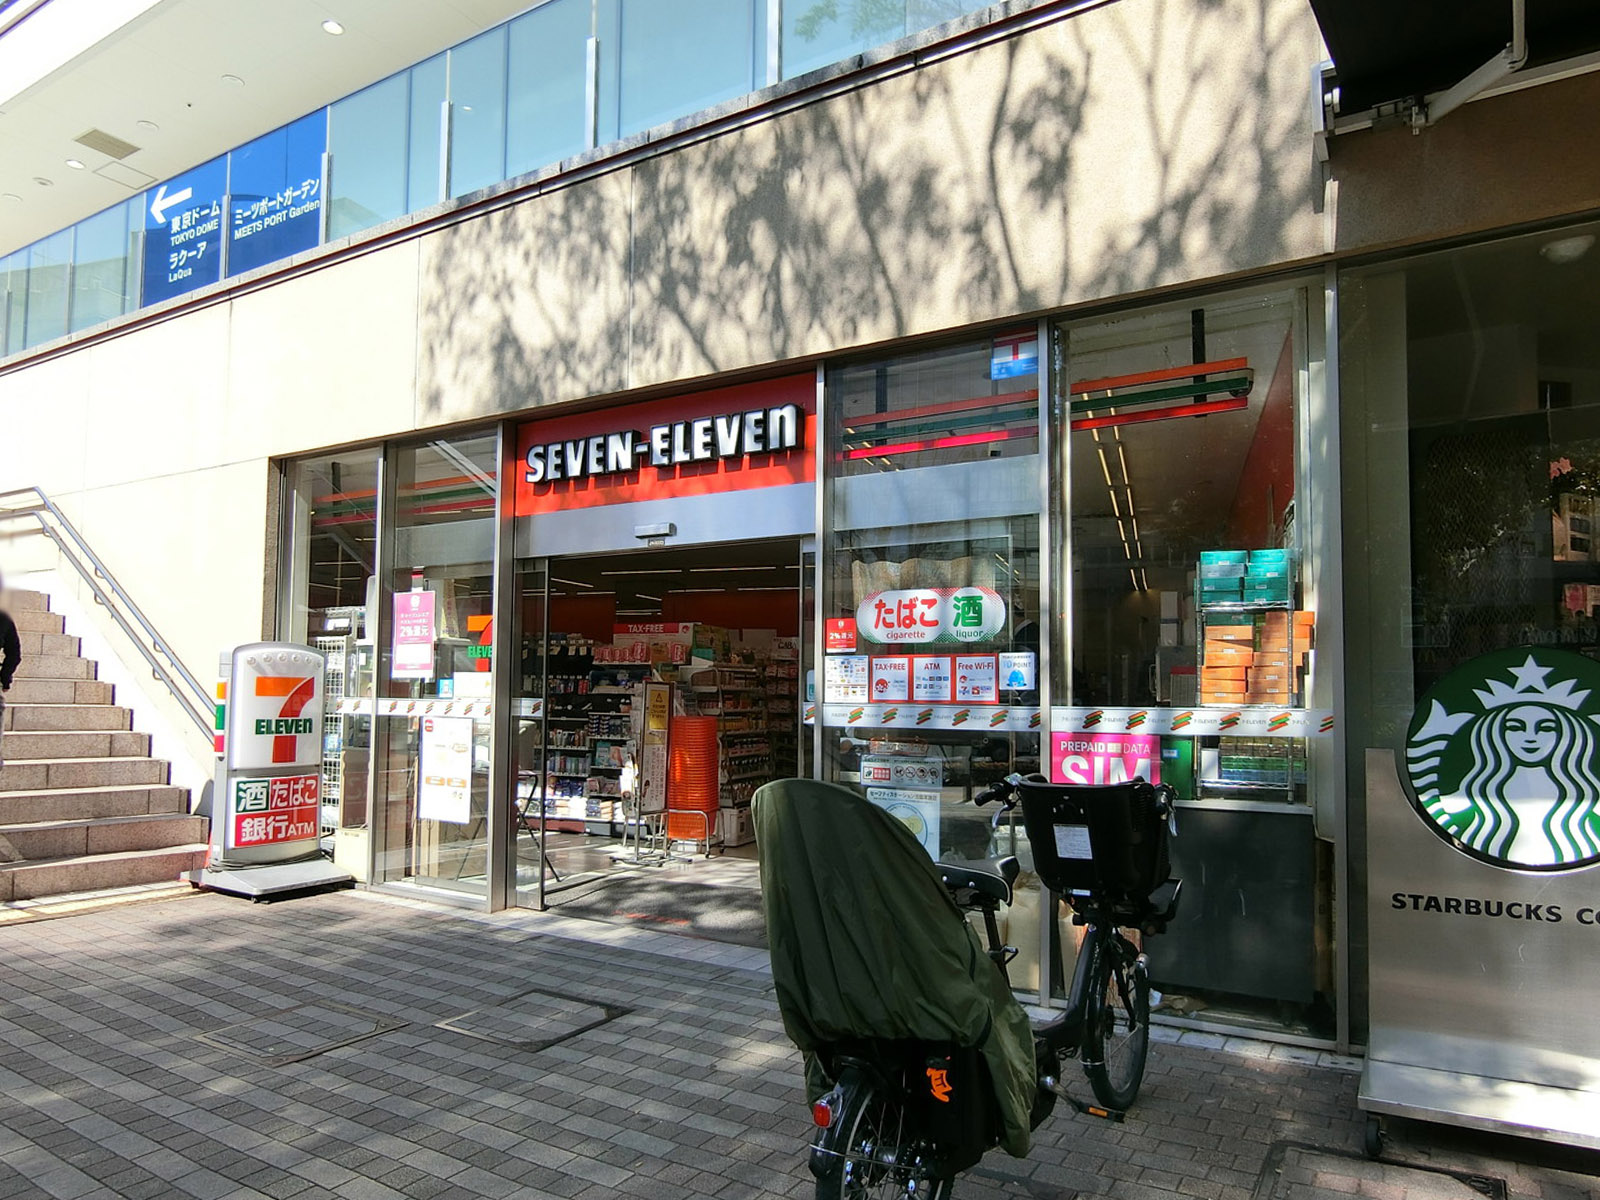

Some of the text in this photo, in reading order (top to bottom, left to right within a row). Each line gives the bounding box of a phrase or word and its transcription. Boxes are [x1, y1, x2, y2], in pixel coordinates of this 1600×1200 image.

[234, 179, 320, 225] ミーツポートガーデン
[171, 200, 220, 234] 東京ドーム
[234, 200, 320, 240] MEETS PORT Garden
[170, 219, 219, 246] TOKYO DOME
[169, 241, 208, 270] ラクーア
[168, 267, 193, 283] LaQua
[874, 595, 983, 630] たばこ 酒
[628, 624, 664, 633] TAX-FREE
[886, 629, 984, 641] cigarette liquor
[924, 663, 941, 671] ATM
[958, 662, 994, 671] Free Wi-Fi
[255, 676, 315, 763] 7
[1060, 741, 1106, 753] PREPAID
[1123, 743, 1151, 754] DATA
[1061, 755, 1151, 785] SIM
[237, 778, 317, 812] 酒 たばこ
[1391, 892, 1600, 925] STARBUCKS C
